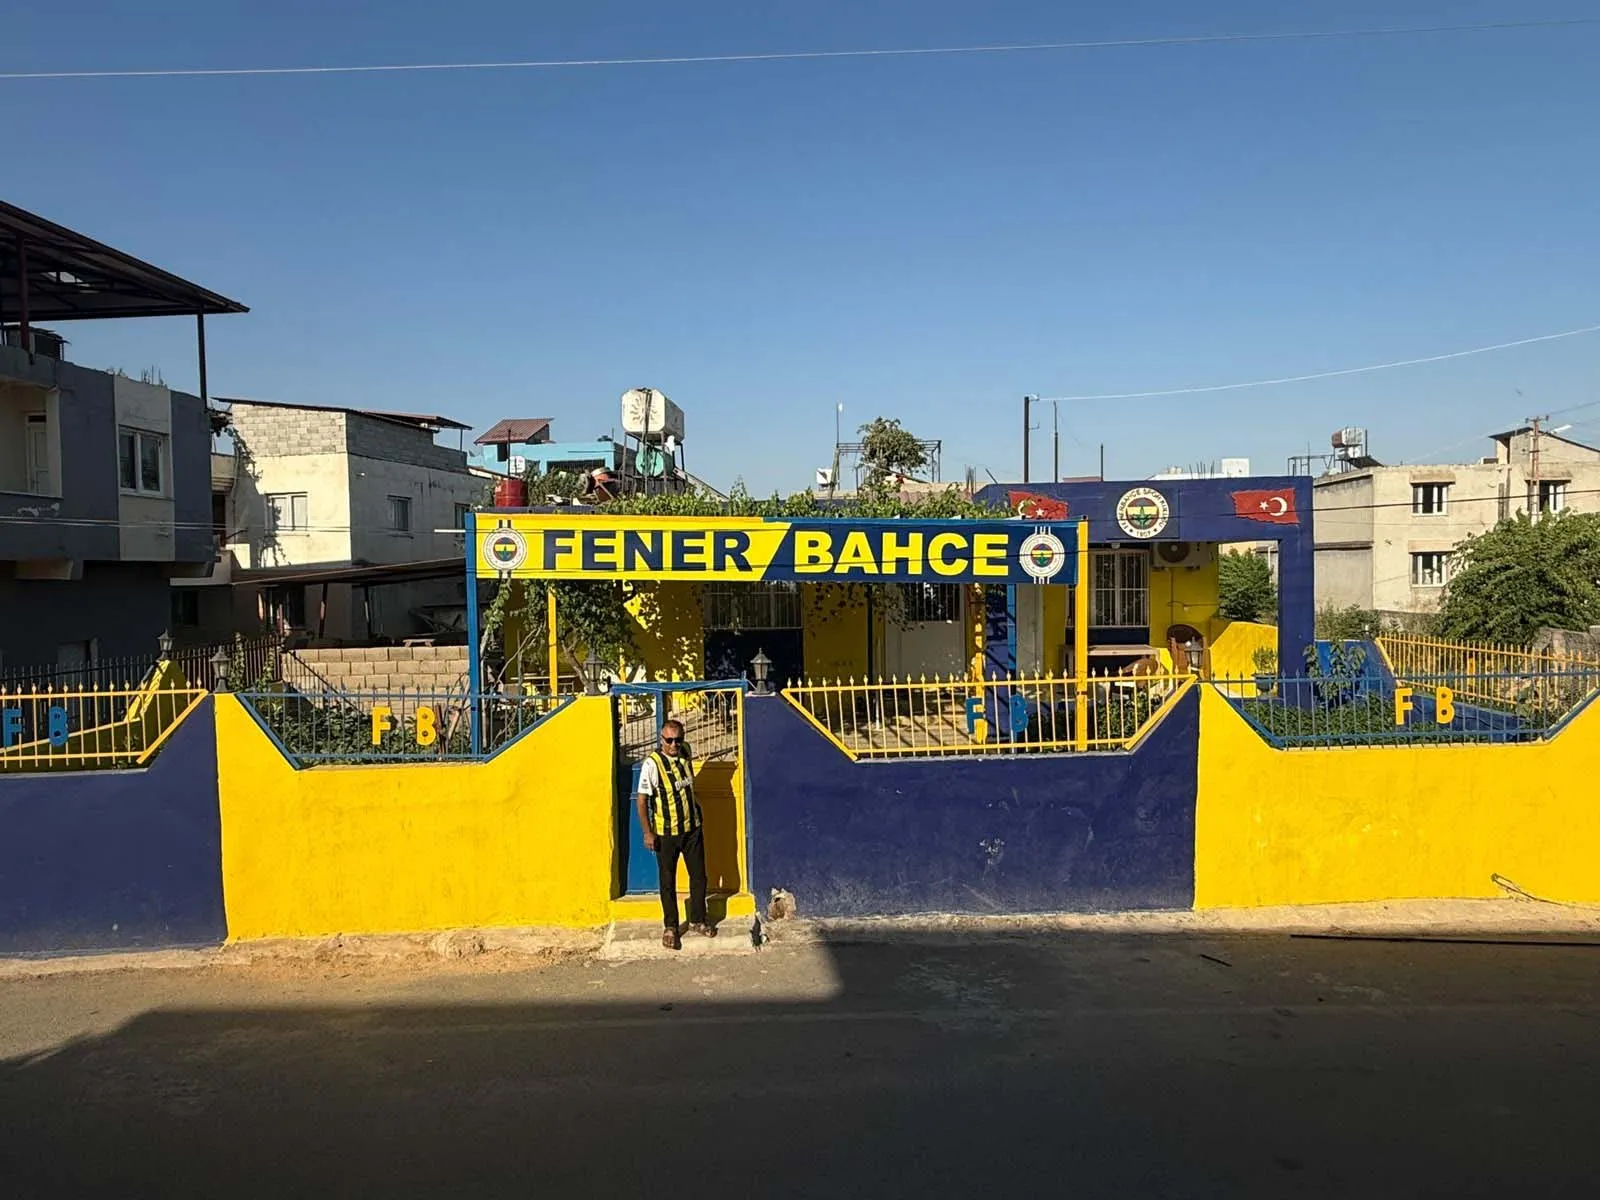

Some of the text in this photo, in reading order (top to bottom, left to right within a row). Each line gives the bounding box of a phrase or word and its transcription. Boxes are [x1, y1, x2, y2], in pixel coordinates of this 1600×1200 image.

[543, 529, 753, 572] FENER
[794, 530, 1009, 577] BAHCE
[1395, 686, 1455, 725] F B
[372, 706, 437, 746] F B
